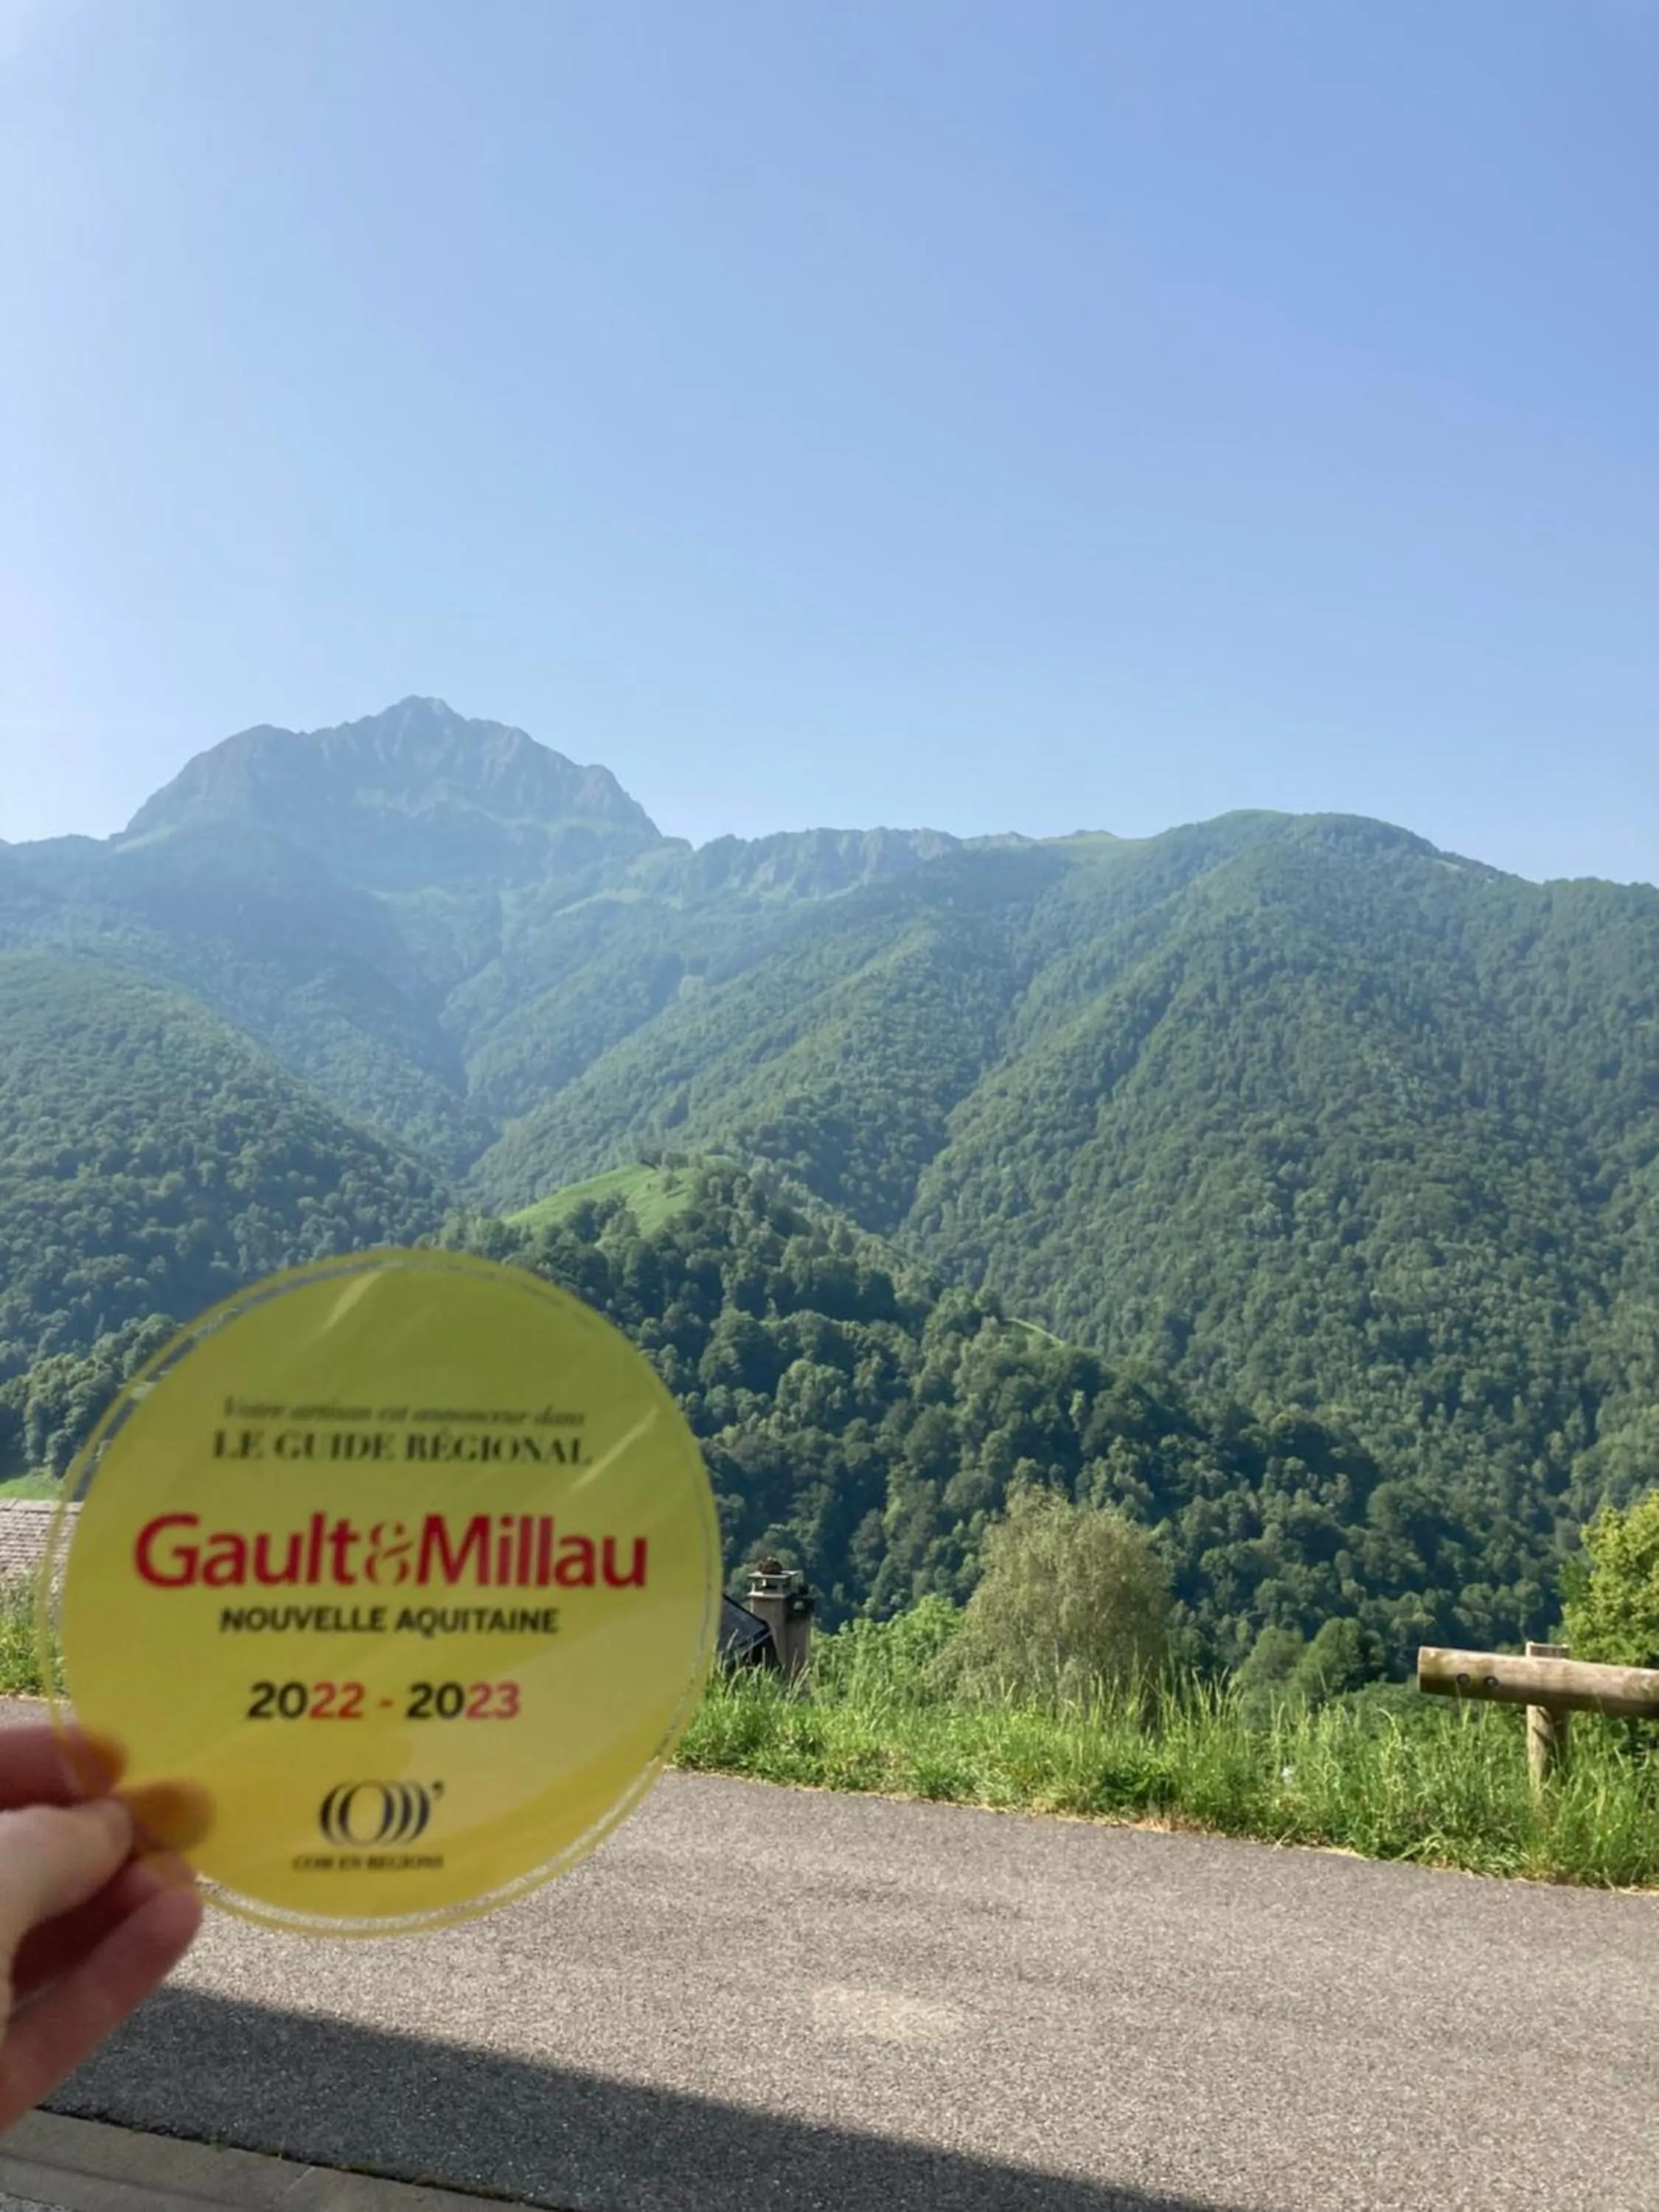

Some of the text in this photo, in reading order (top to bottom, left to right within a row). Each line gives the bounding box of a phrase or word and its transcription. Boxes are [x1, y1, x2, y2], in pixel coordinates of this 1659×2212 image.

[212, 1425, 594, 1466] LE GUIDE RÉGIONAL
[220, 1605, 559, 1638] NOUVELLE AQUITAINE
[246, 1681, 365, 1719] 2022
[406, 1681, 521, 1719] 2023
